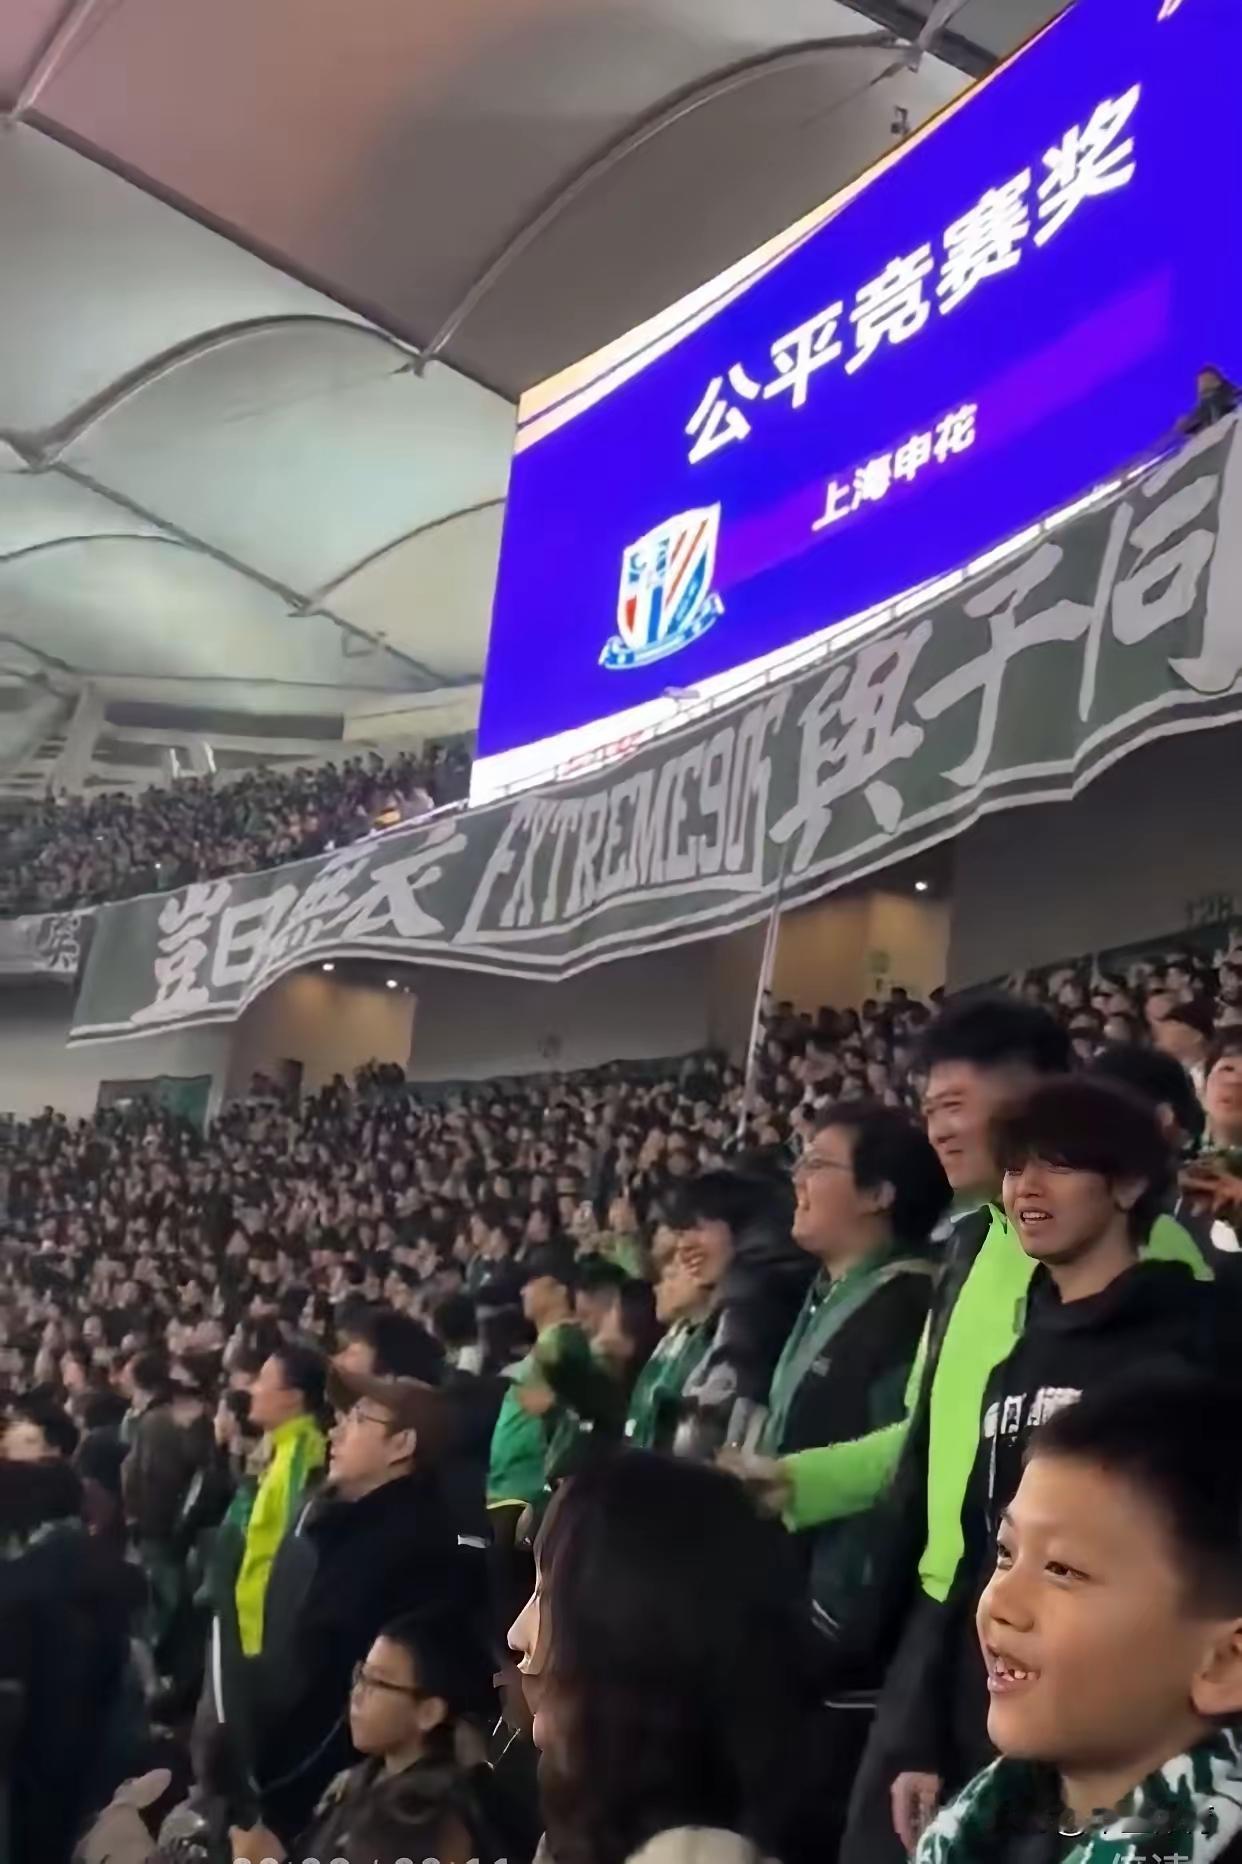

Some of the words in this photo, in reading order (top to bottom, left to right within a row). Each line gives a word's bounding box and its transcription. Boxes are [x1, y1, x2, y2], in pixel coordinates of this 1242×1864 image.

[685, 83, 1141, 464] 公平竞赛奖
[811, 403, 978, 531] 上海申花
